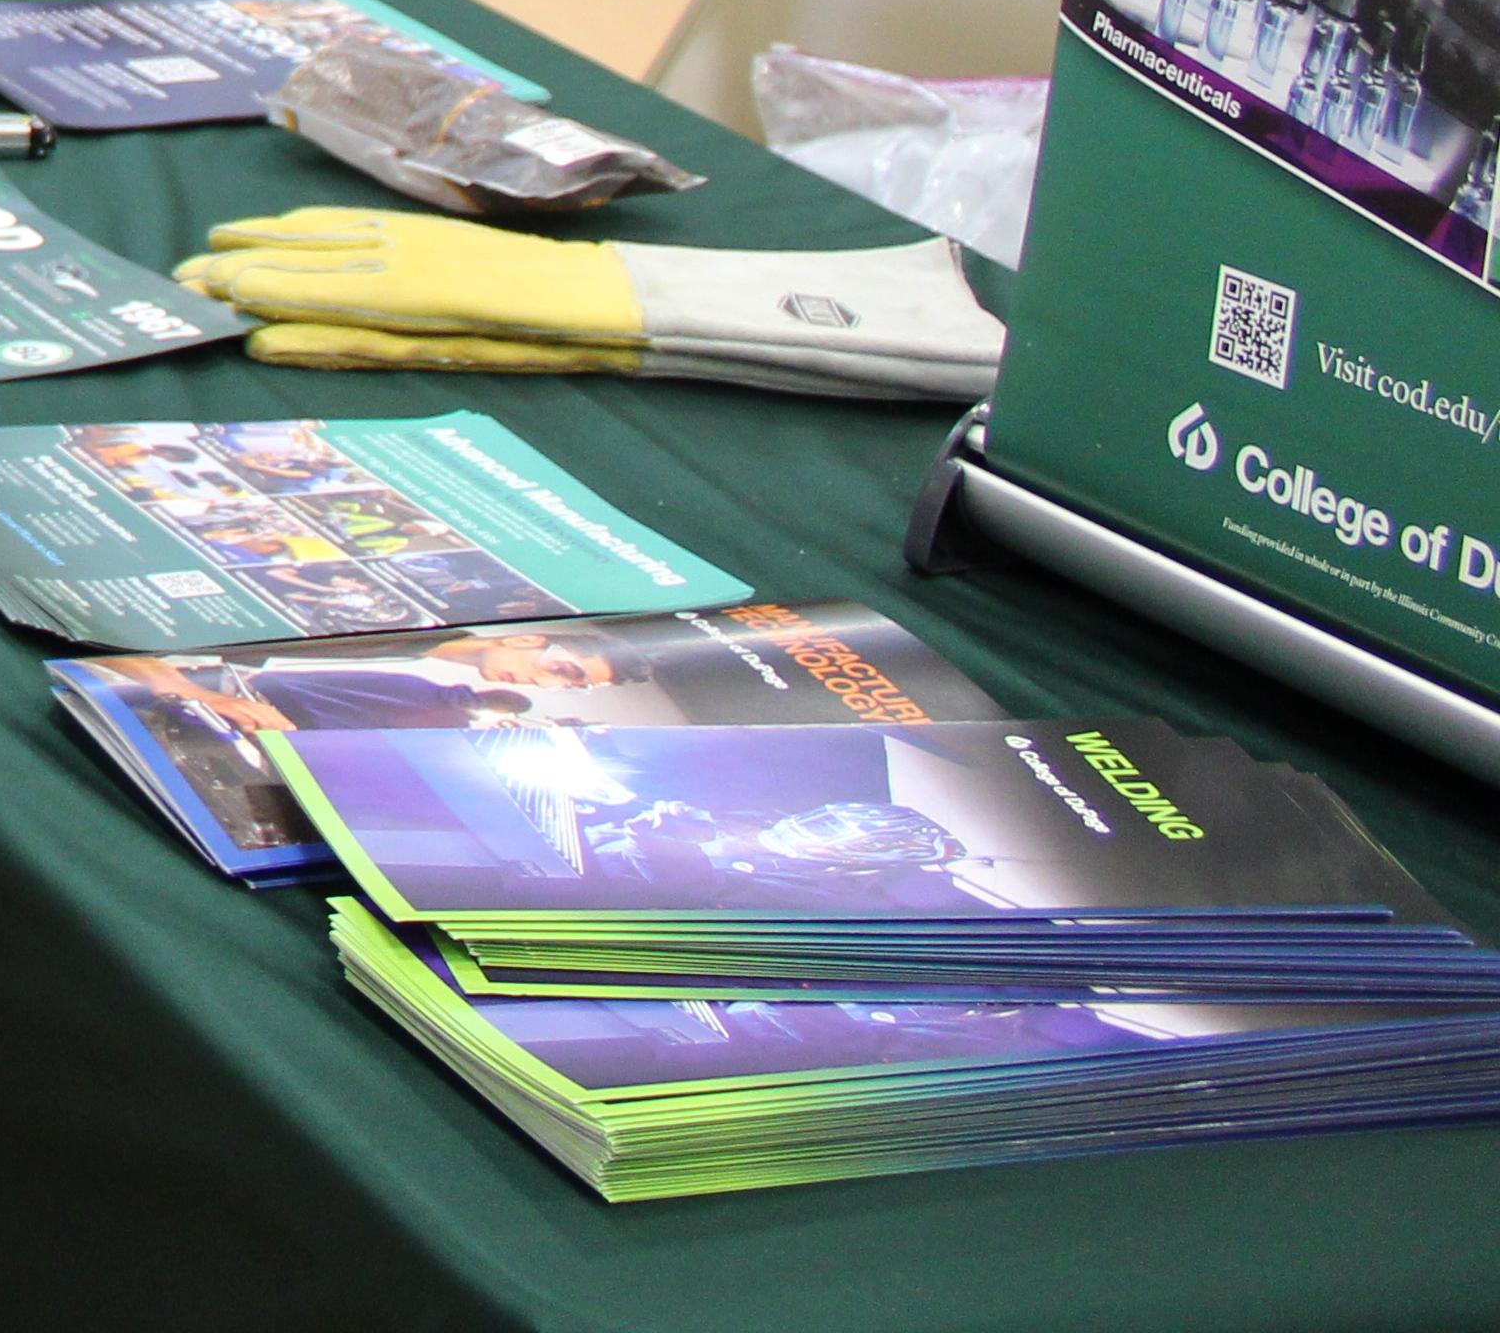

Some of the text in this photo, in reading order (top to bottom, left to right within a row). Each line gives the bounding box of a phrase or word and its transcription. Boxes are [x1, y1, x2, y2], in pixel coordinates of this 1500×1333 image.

[1092, 10, 1242, 120] Pharmaceuticals
[109, 298, 203, 341] 1967
[1316, 340, 1500, 445] Visit cod.edu/
[1236, 443, 1500, 600] College of D
[1065, 730, 1205, 840] WELDING
